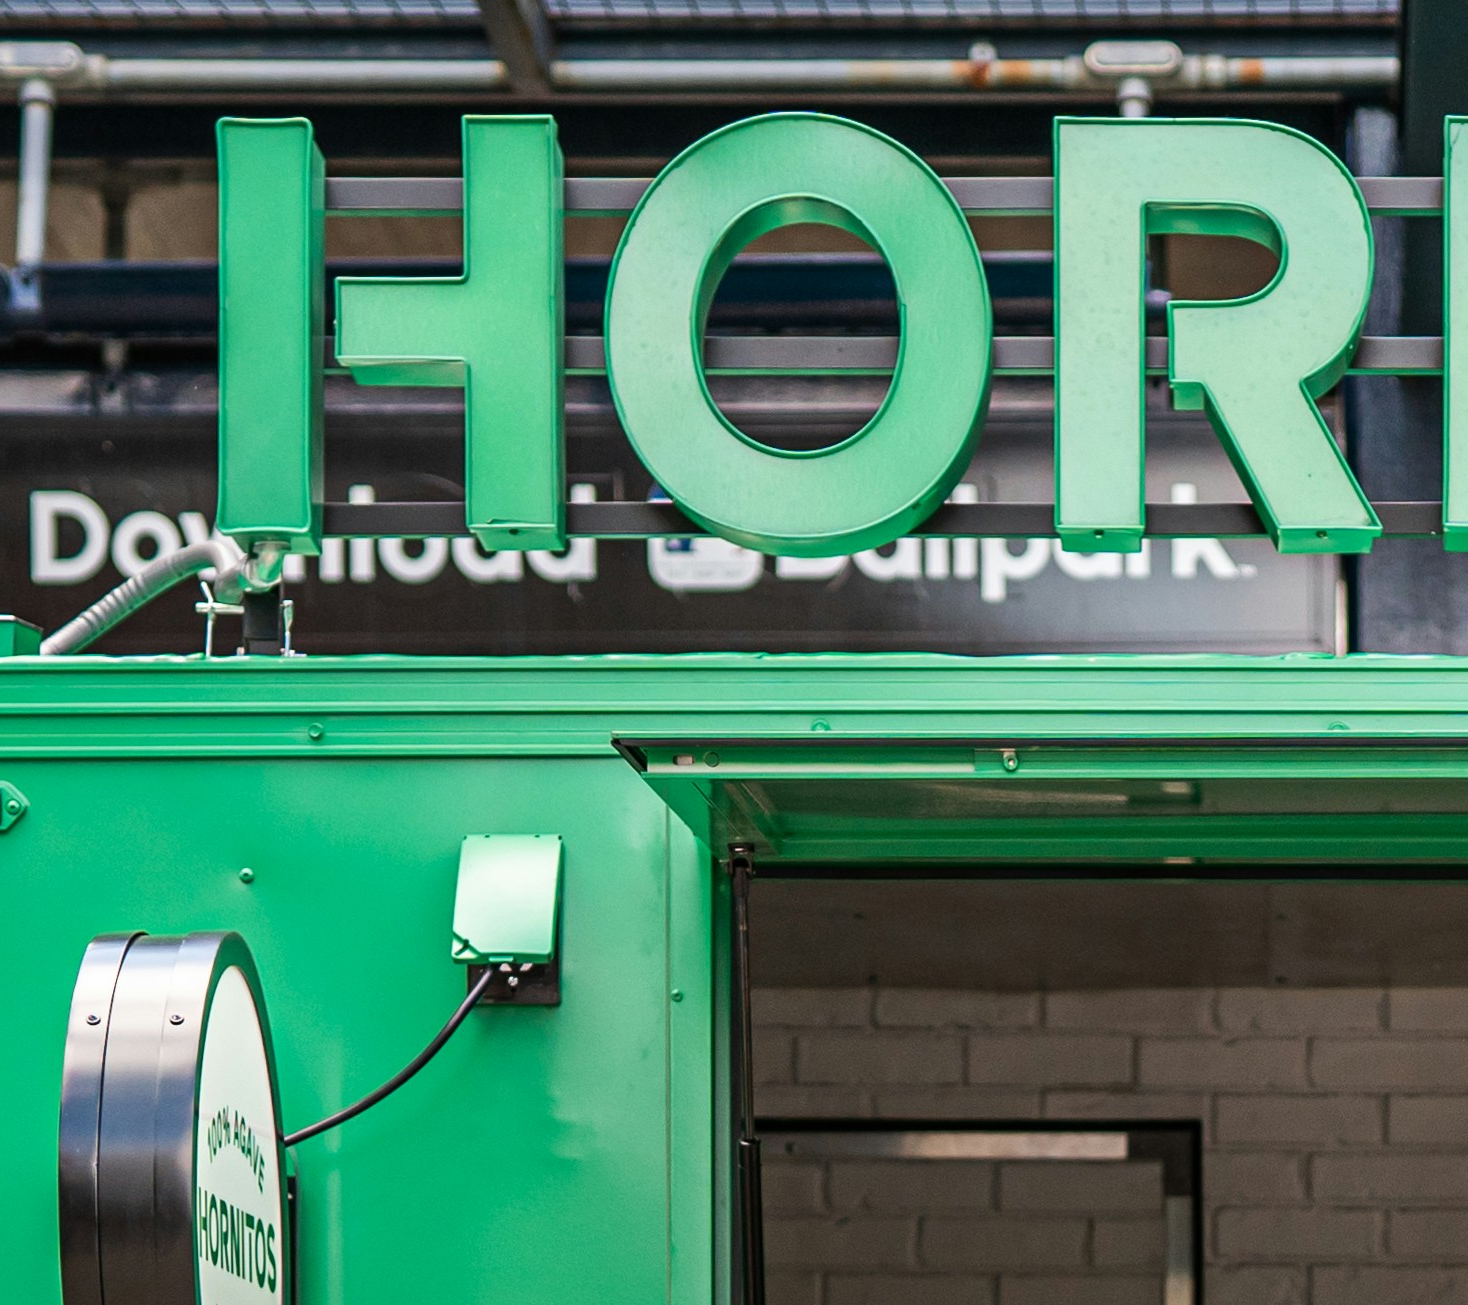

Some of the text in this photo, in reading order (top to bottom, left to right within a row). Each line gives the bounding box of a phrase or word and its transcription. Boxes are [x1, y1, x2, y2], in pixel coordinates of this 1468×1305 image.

[207, 1105, 265, 1194] 100% AGAVE
[198, 1186, 277, 1294] HORNITOS
